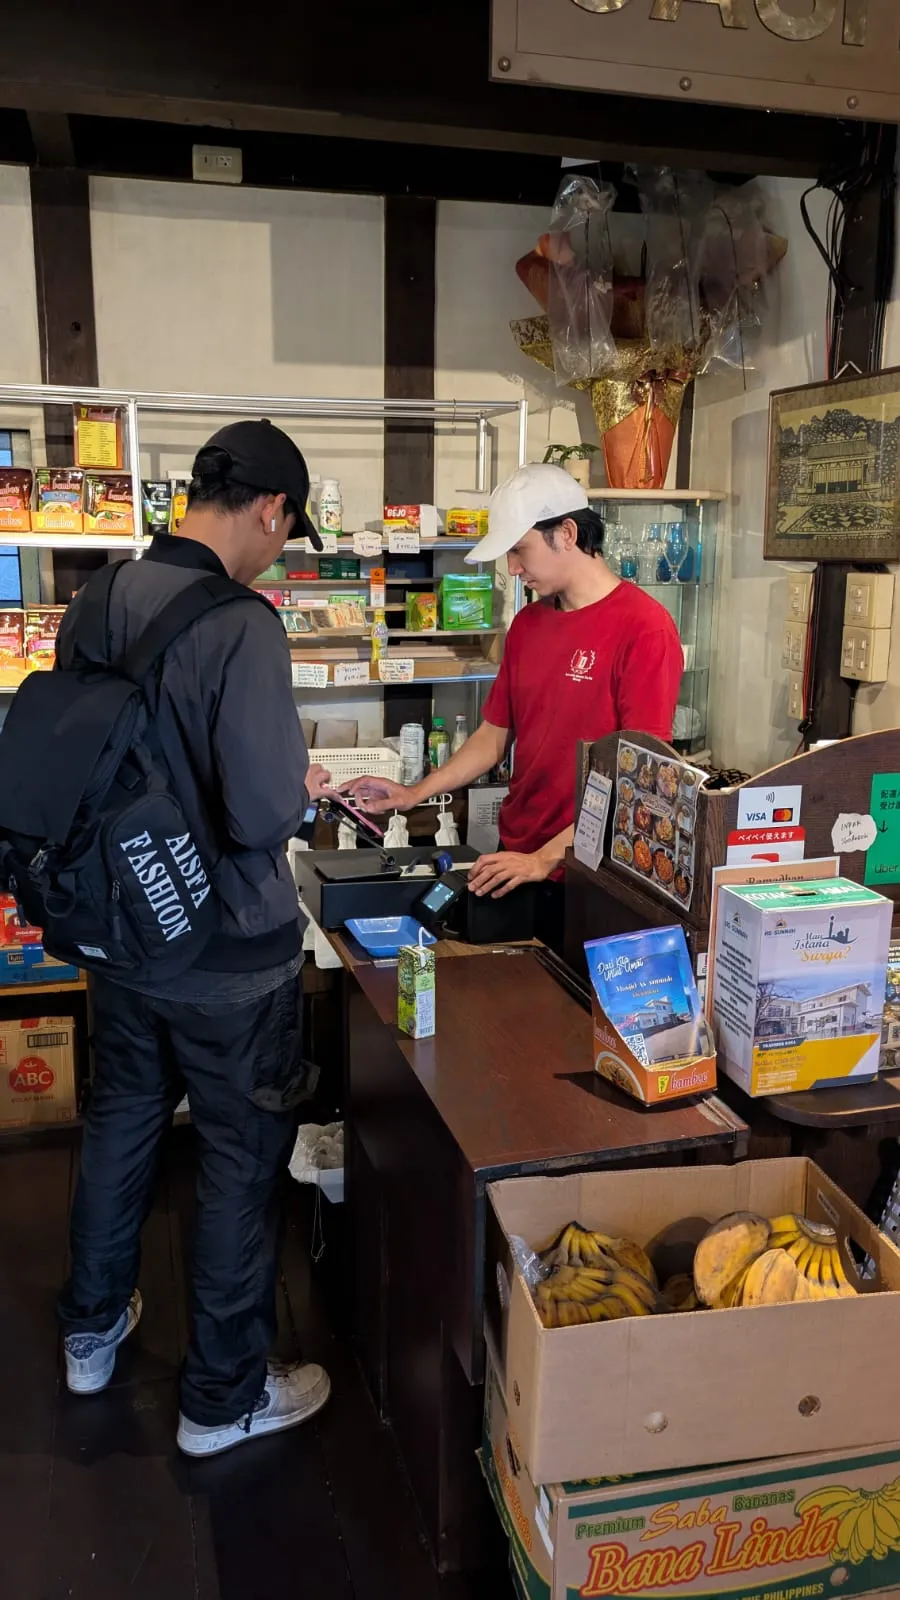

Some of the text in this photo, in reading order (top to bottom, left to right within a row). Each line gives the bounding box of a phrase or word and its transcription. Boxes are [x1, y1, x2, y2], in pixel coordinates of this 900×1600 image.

[746, 812, 767, 821] VISA
[738, 831, 794, 841] ペイペイ使えます
[165, 832, 211, 909] AISFA
[874, 863, 898, 874] Uber
[119, 830, 192, 942] FASHION
[792, 939, 830, 951] Istana
[800, 946, 851, 964] Surga?
[14, 1070, 51, 1088] ABC
[575, 1489, 796, 1542] Premium Saba Bananas
[579, 1505, 842, 1598] Bana Linda
[764, 1583, 824, 1600] PHILIPPINES
